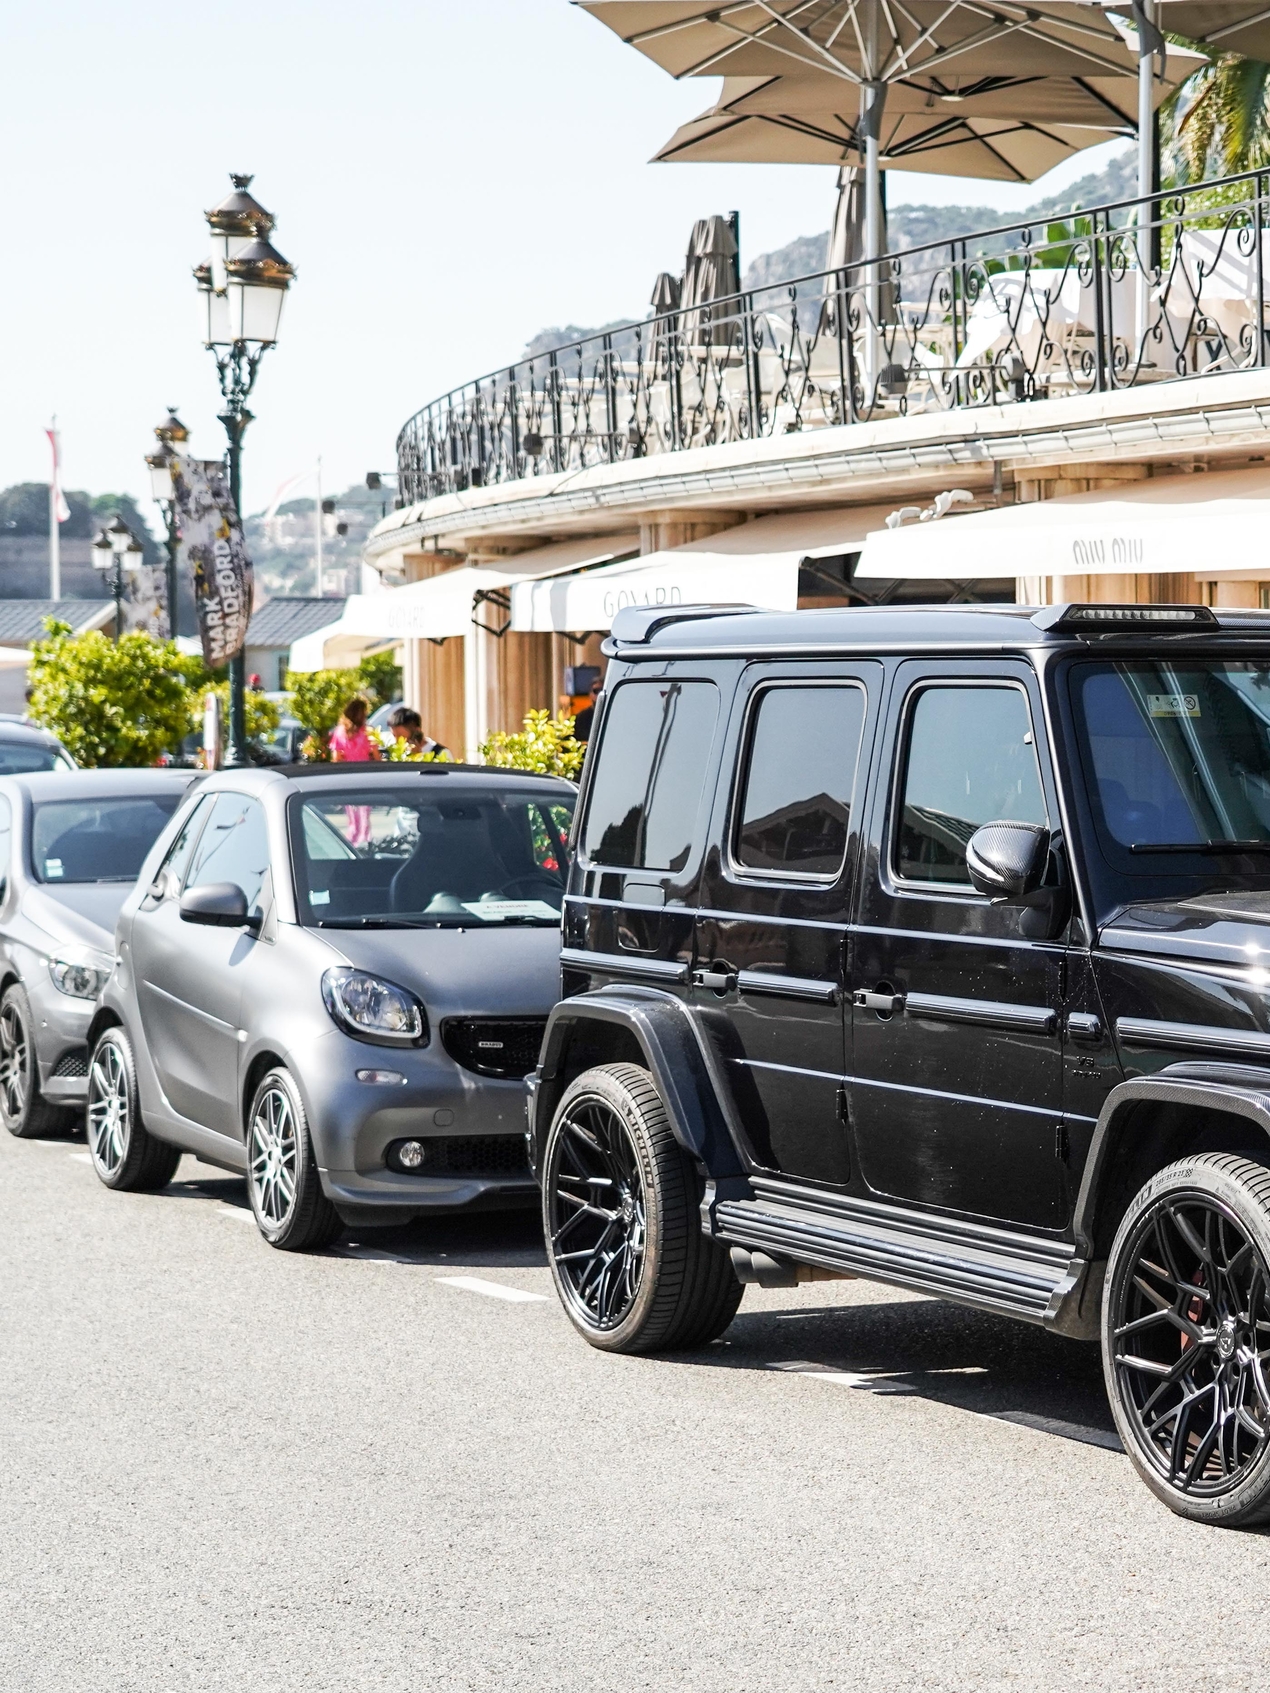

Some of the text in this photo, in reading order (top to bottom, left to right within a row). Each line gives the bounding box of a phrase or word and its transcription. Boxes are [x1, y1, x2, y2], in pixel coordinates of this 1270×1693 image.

[204, 597, 225, 660] MARK
[214, 540, 240, 655] BRADFORD
[627, 1113, 654, 1186] MICHELIN
